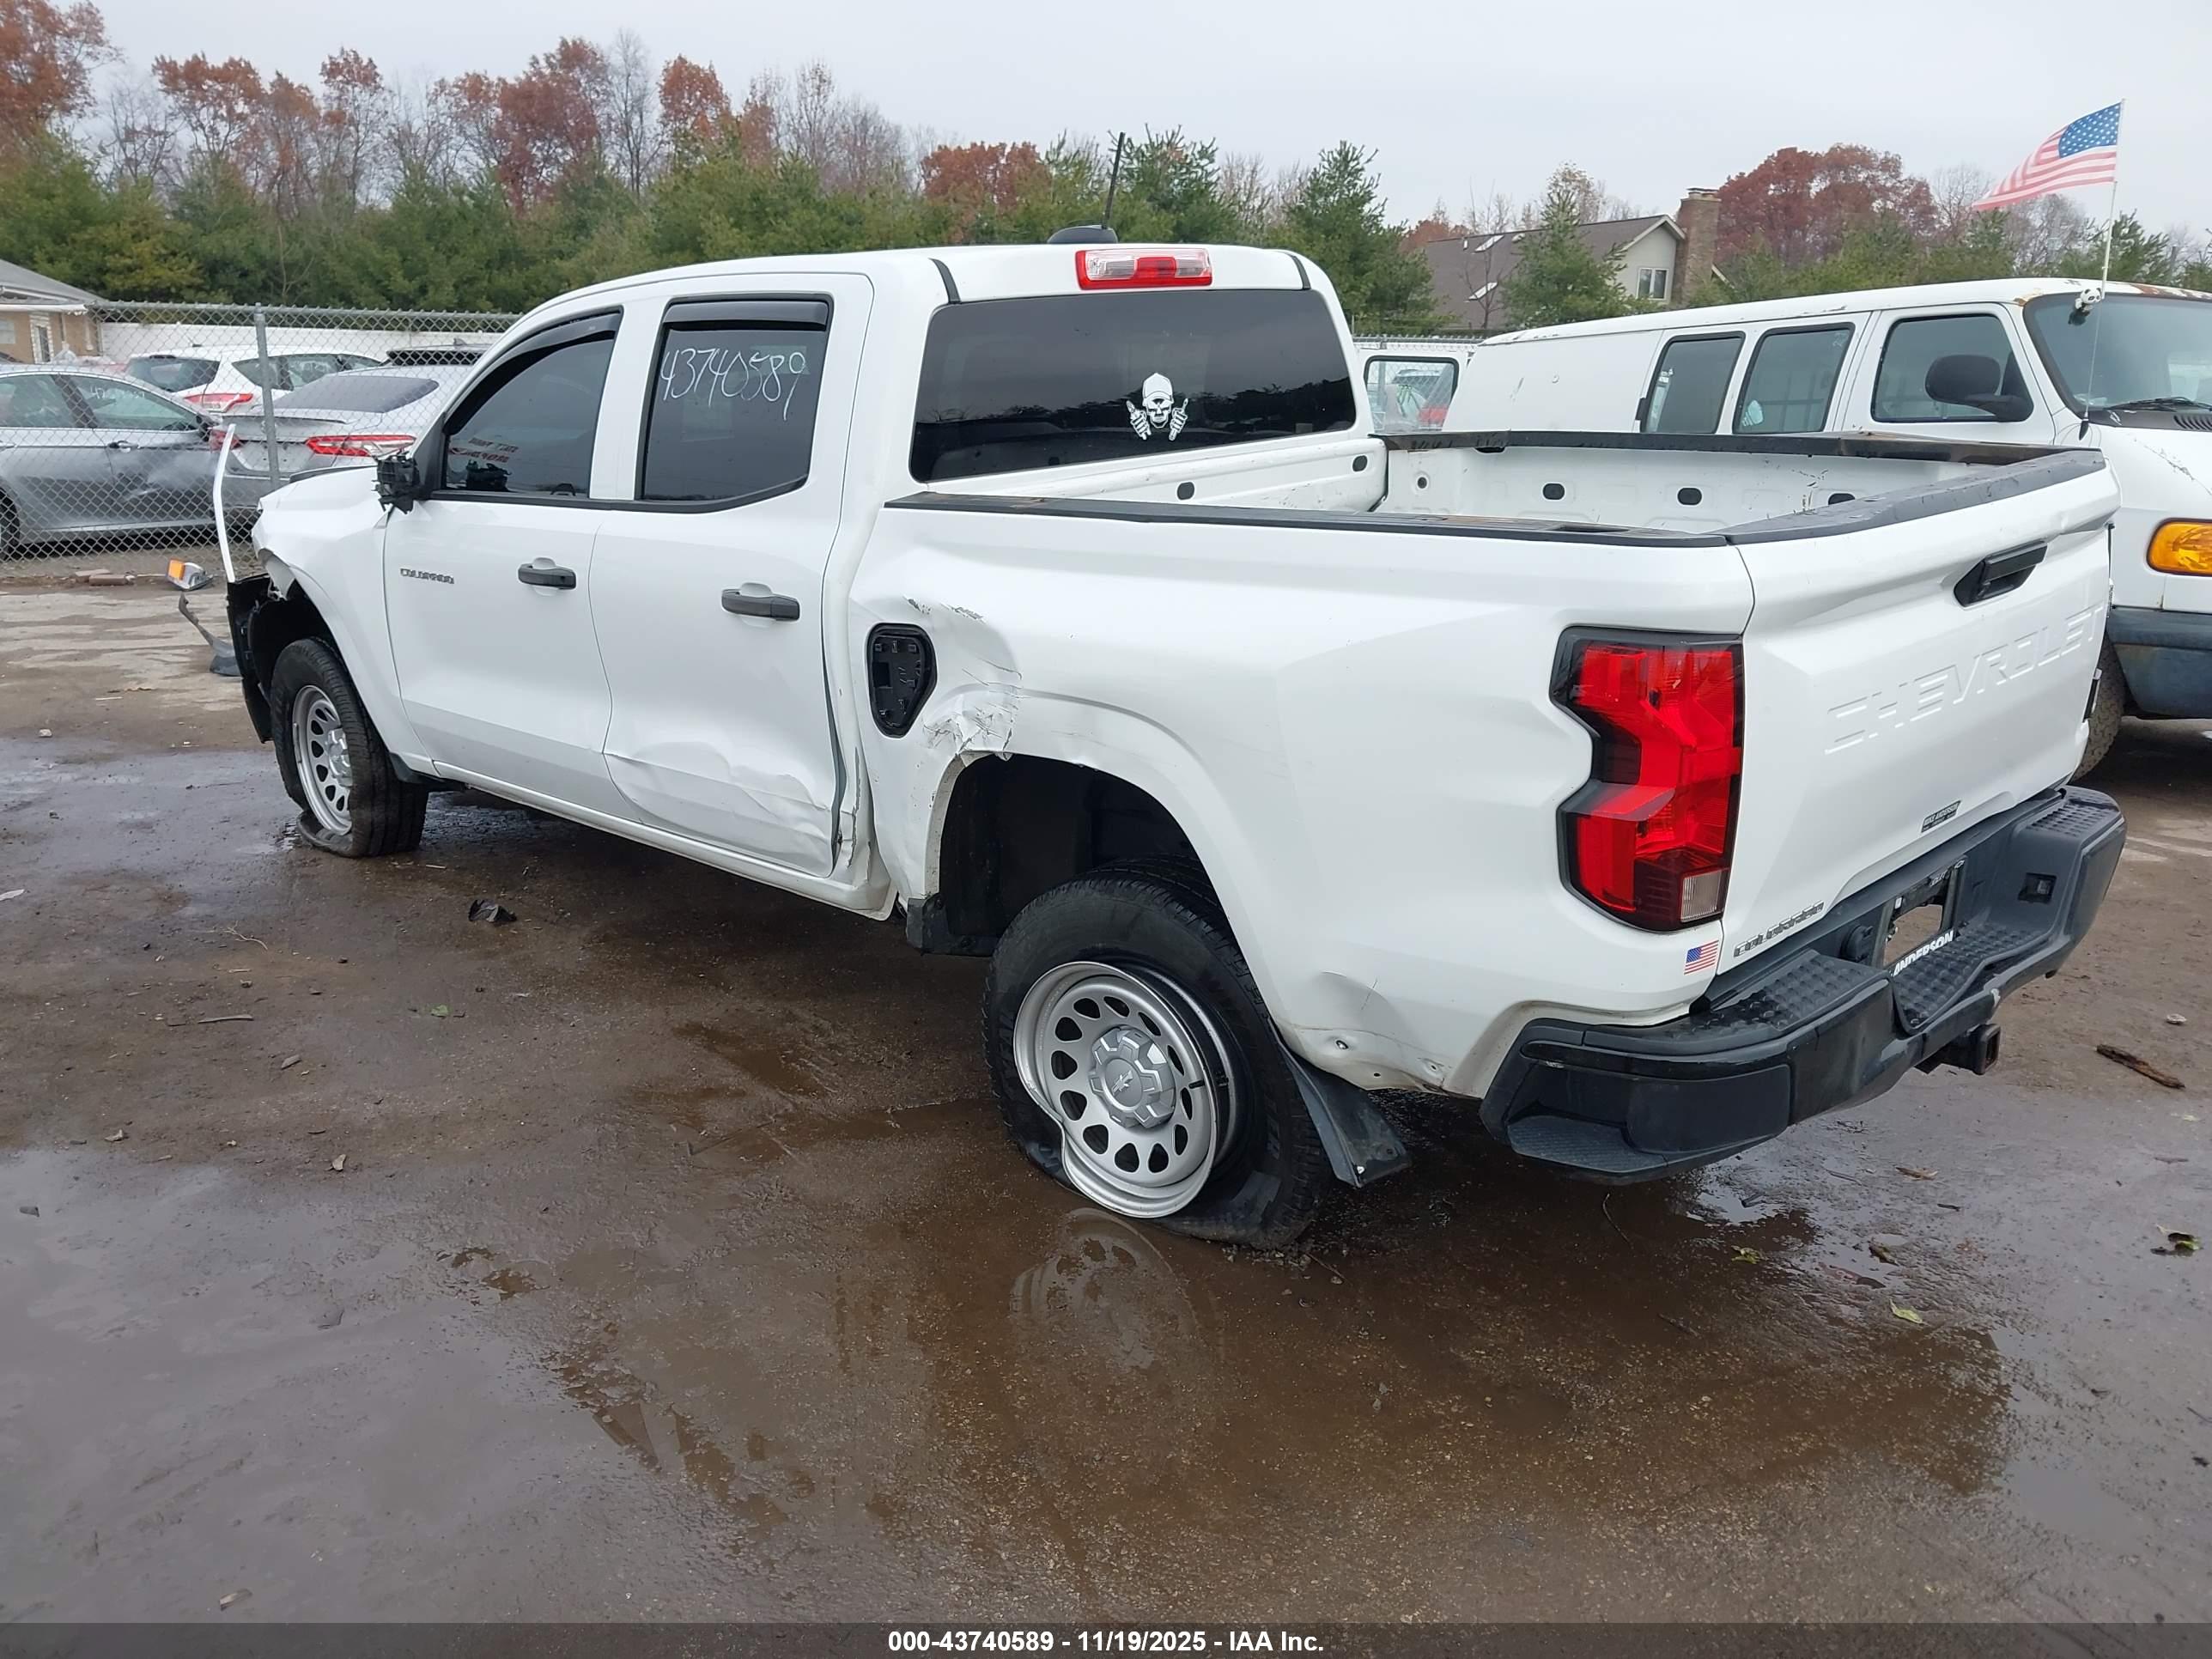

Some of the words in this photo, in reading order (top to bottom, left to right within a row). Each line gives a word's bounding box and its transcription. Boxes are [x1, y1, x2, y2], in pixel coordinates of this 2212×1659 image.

[659, 348, 806, 421] 43740589
[1825, 605, 2105, 756] CHEVROLET
[1733, 900, 1825, 957] COLORADO
[1893, 930, 1954, 977] ANDERSON
